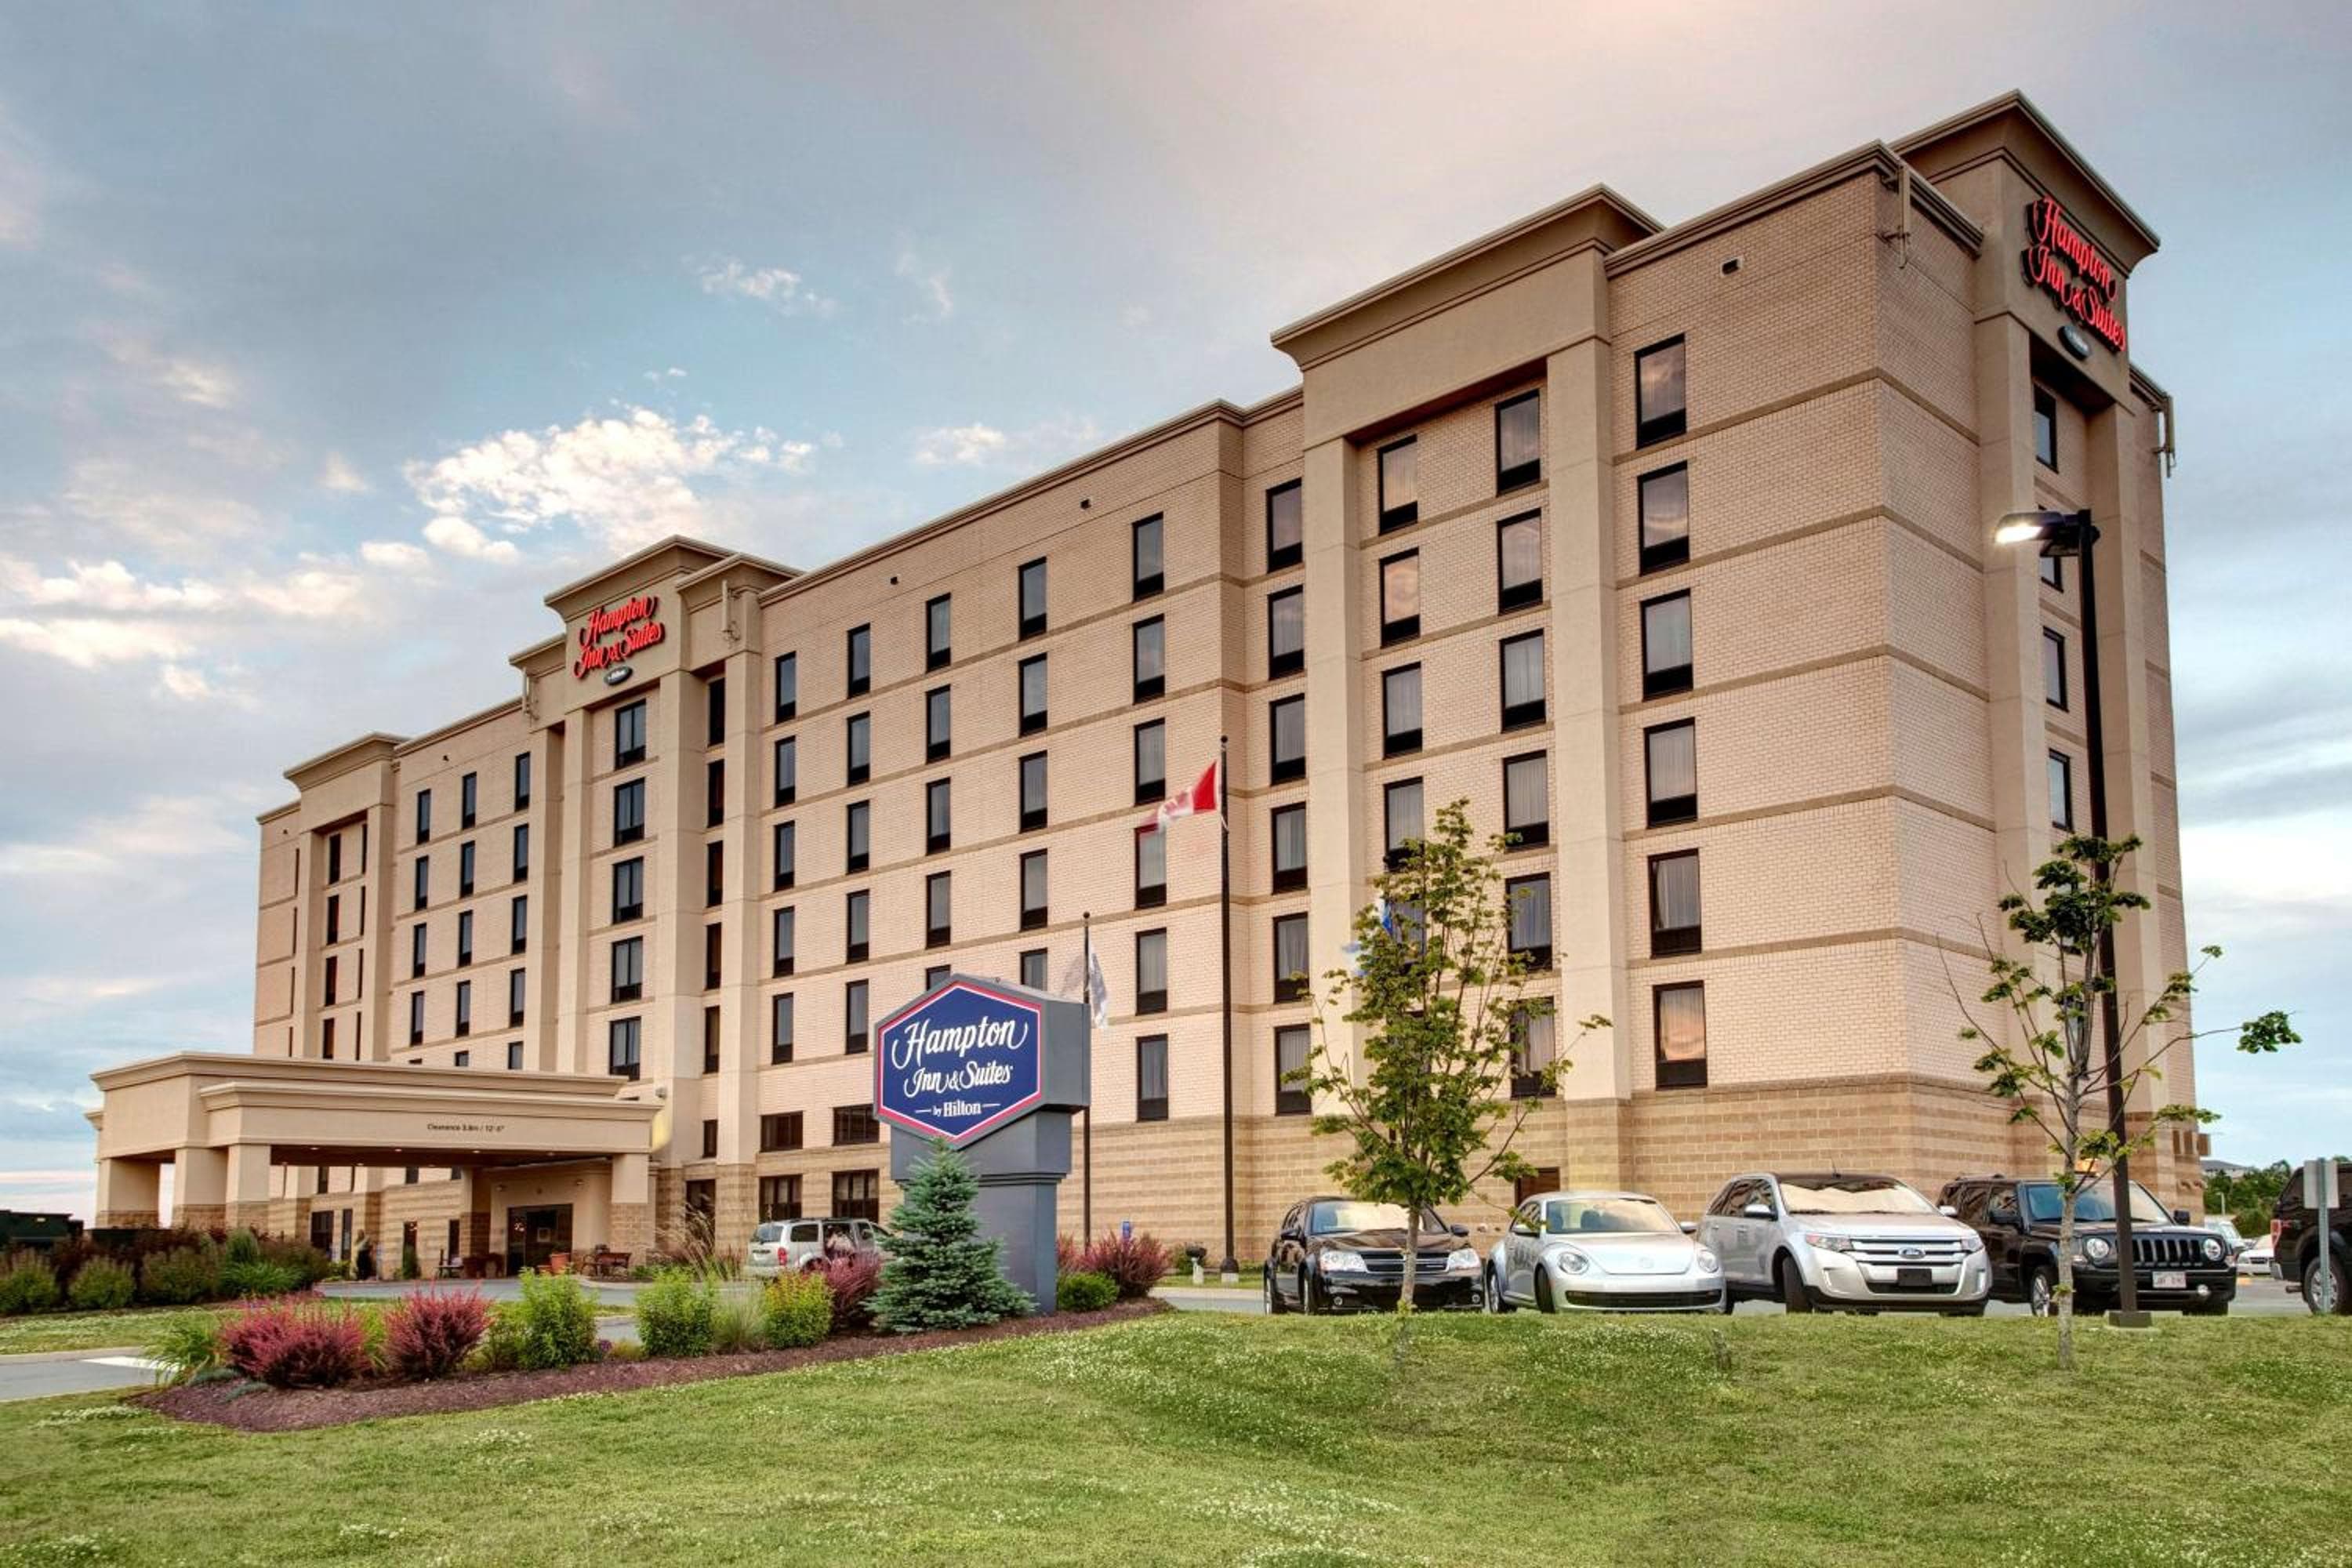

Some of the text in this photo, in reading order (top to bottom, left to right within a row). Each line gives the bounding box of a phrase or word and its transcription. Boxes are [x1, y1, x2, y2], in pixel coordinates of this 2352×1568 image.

[2033, 197, 2117, 302] Hampton
[2028, 245, 2072, 306] Inn
[2082, 286, 2126, 352] Suites
[579, 594, 659, 648] Hampton
[573, 645, 609, 679] Inn
[620, 620, 664, 657] Suites
[891, 1016, 1029, 1069] Hampton
[904, 1060, 1012, 1098] Inn & Suites
[933, 1099, 982, 1117] by Hilton
